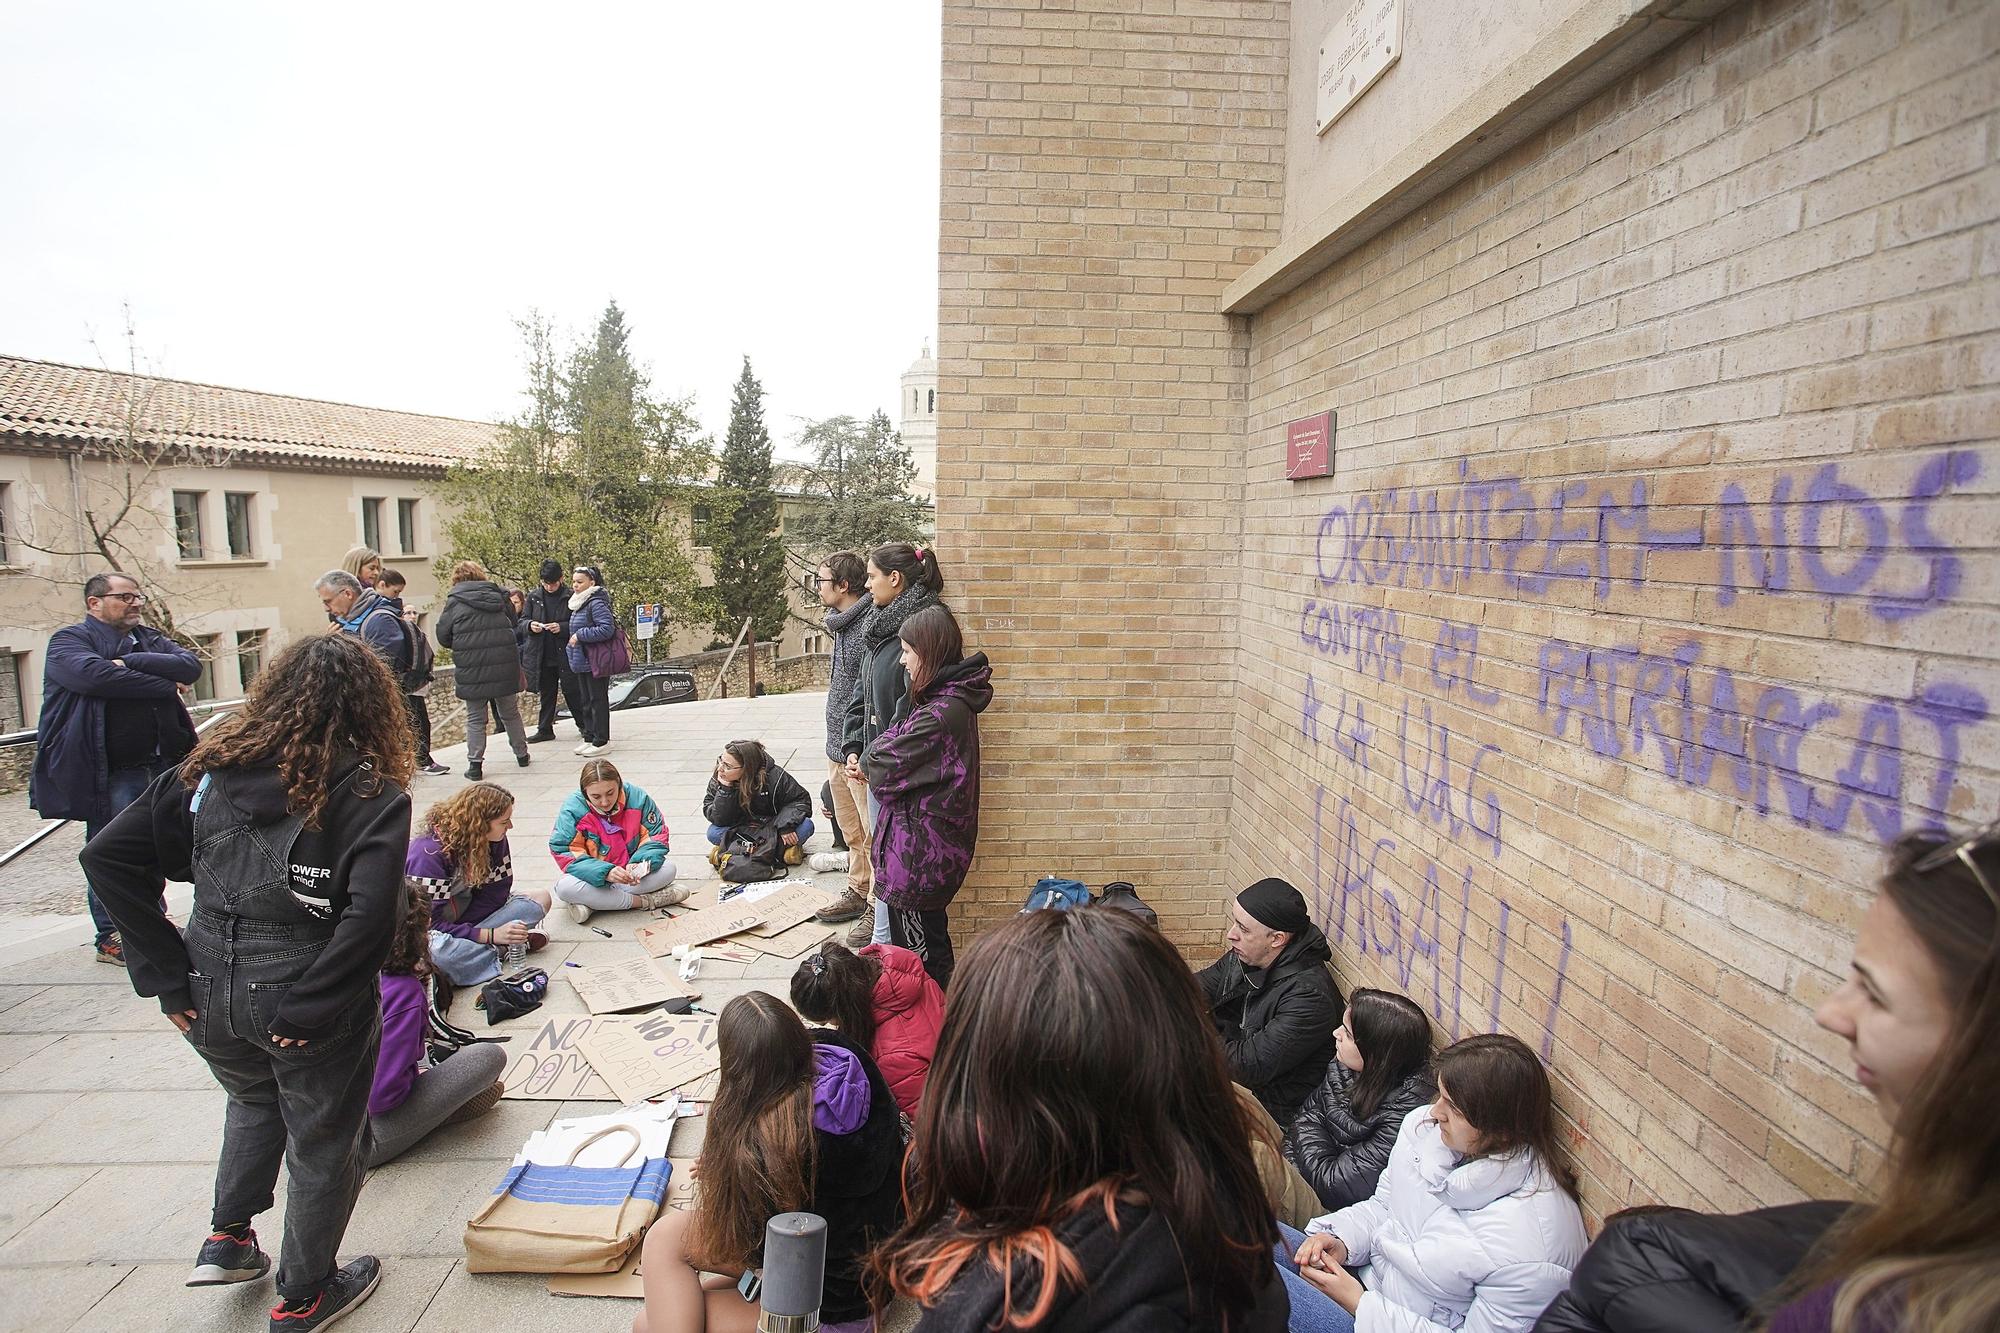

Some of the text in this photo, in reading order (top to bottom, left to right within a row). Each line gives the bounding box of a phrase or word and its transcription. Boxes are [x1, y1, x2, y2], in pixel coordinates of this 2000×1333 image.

[1337, 27, 1367, 69] FERRATER
[1302, 672, 1321, 744] A
[1301, 601, 1404, 682] CONTRA
[1537, 640, 1990, 845] PATRIARCAT
[289, 864, 331, 879] OWER
[293, 875, 317, 888] mind.
[727, 916, 758, 931] CAP
[632, 1015, 676, 1042] NO
